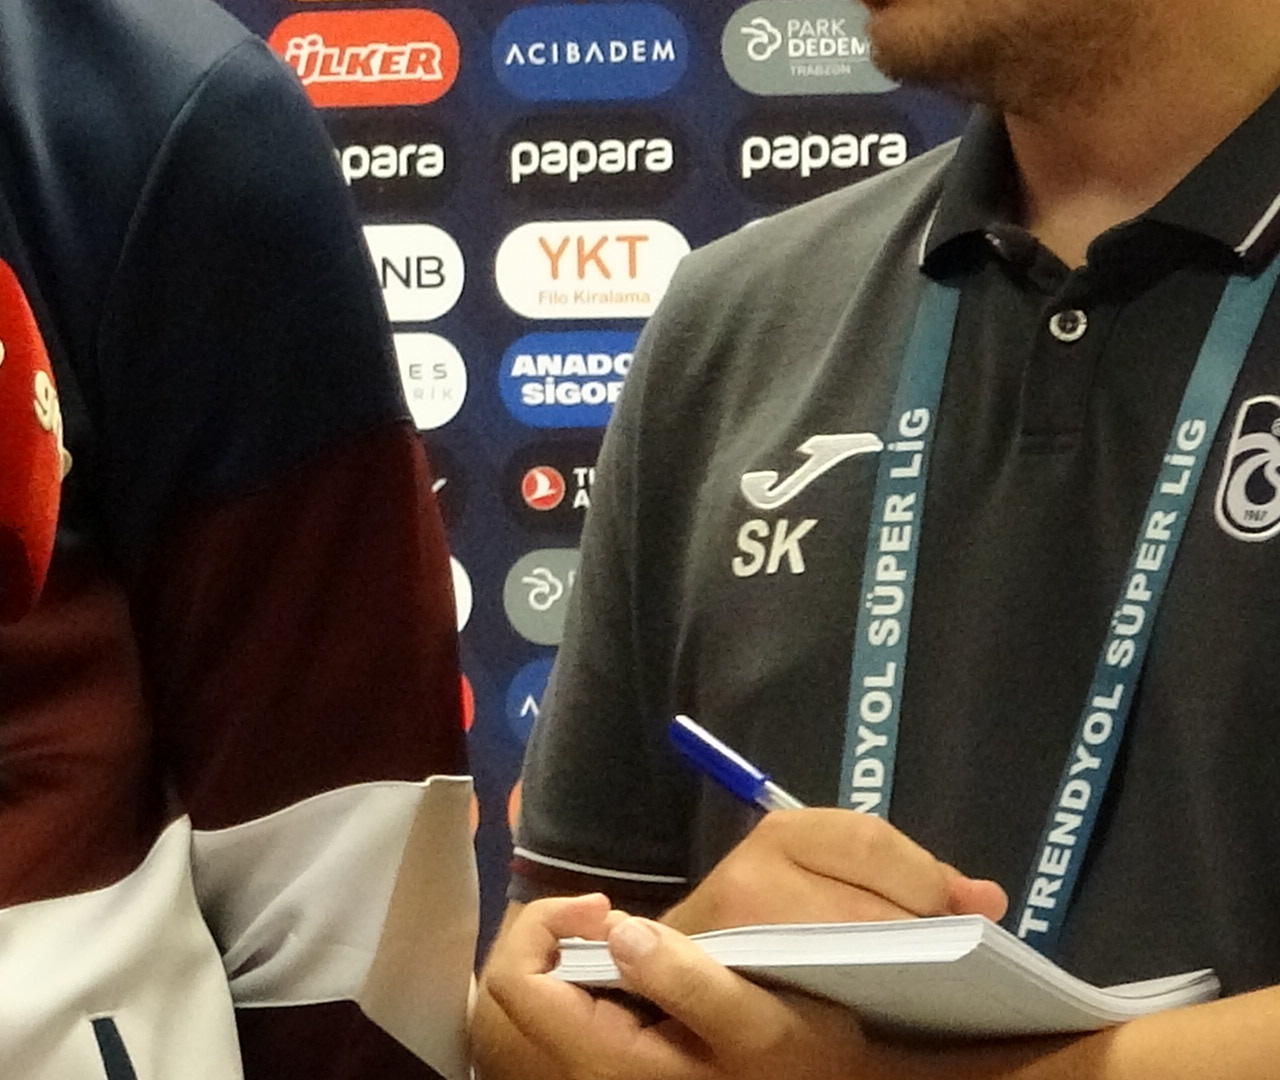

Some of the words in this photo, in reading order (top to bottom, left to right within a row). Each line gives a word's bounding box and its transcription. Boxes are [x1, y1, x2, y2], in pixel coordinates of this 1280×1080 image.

[788, 18, 847, 38] PARK
[505, 38, 676, 66] ACIBADEM
[335, 143, 445, 187] para
[511, 138, 674, 184] papara
[742, 131, 908, 179] papara
[539, 235, 649, 280] YKT
[887, 407, 932, 480] LİG
[732, 519, 818, 577] SK
[866, 492, 919, 648] SÜPER
[1018, 683, 1124, 938] TRENDYOL
[1106, 510, 1178, 668] SÜPER
[1160, 418, 1207, 496] LİG
